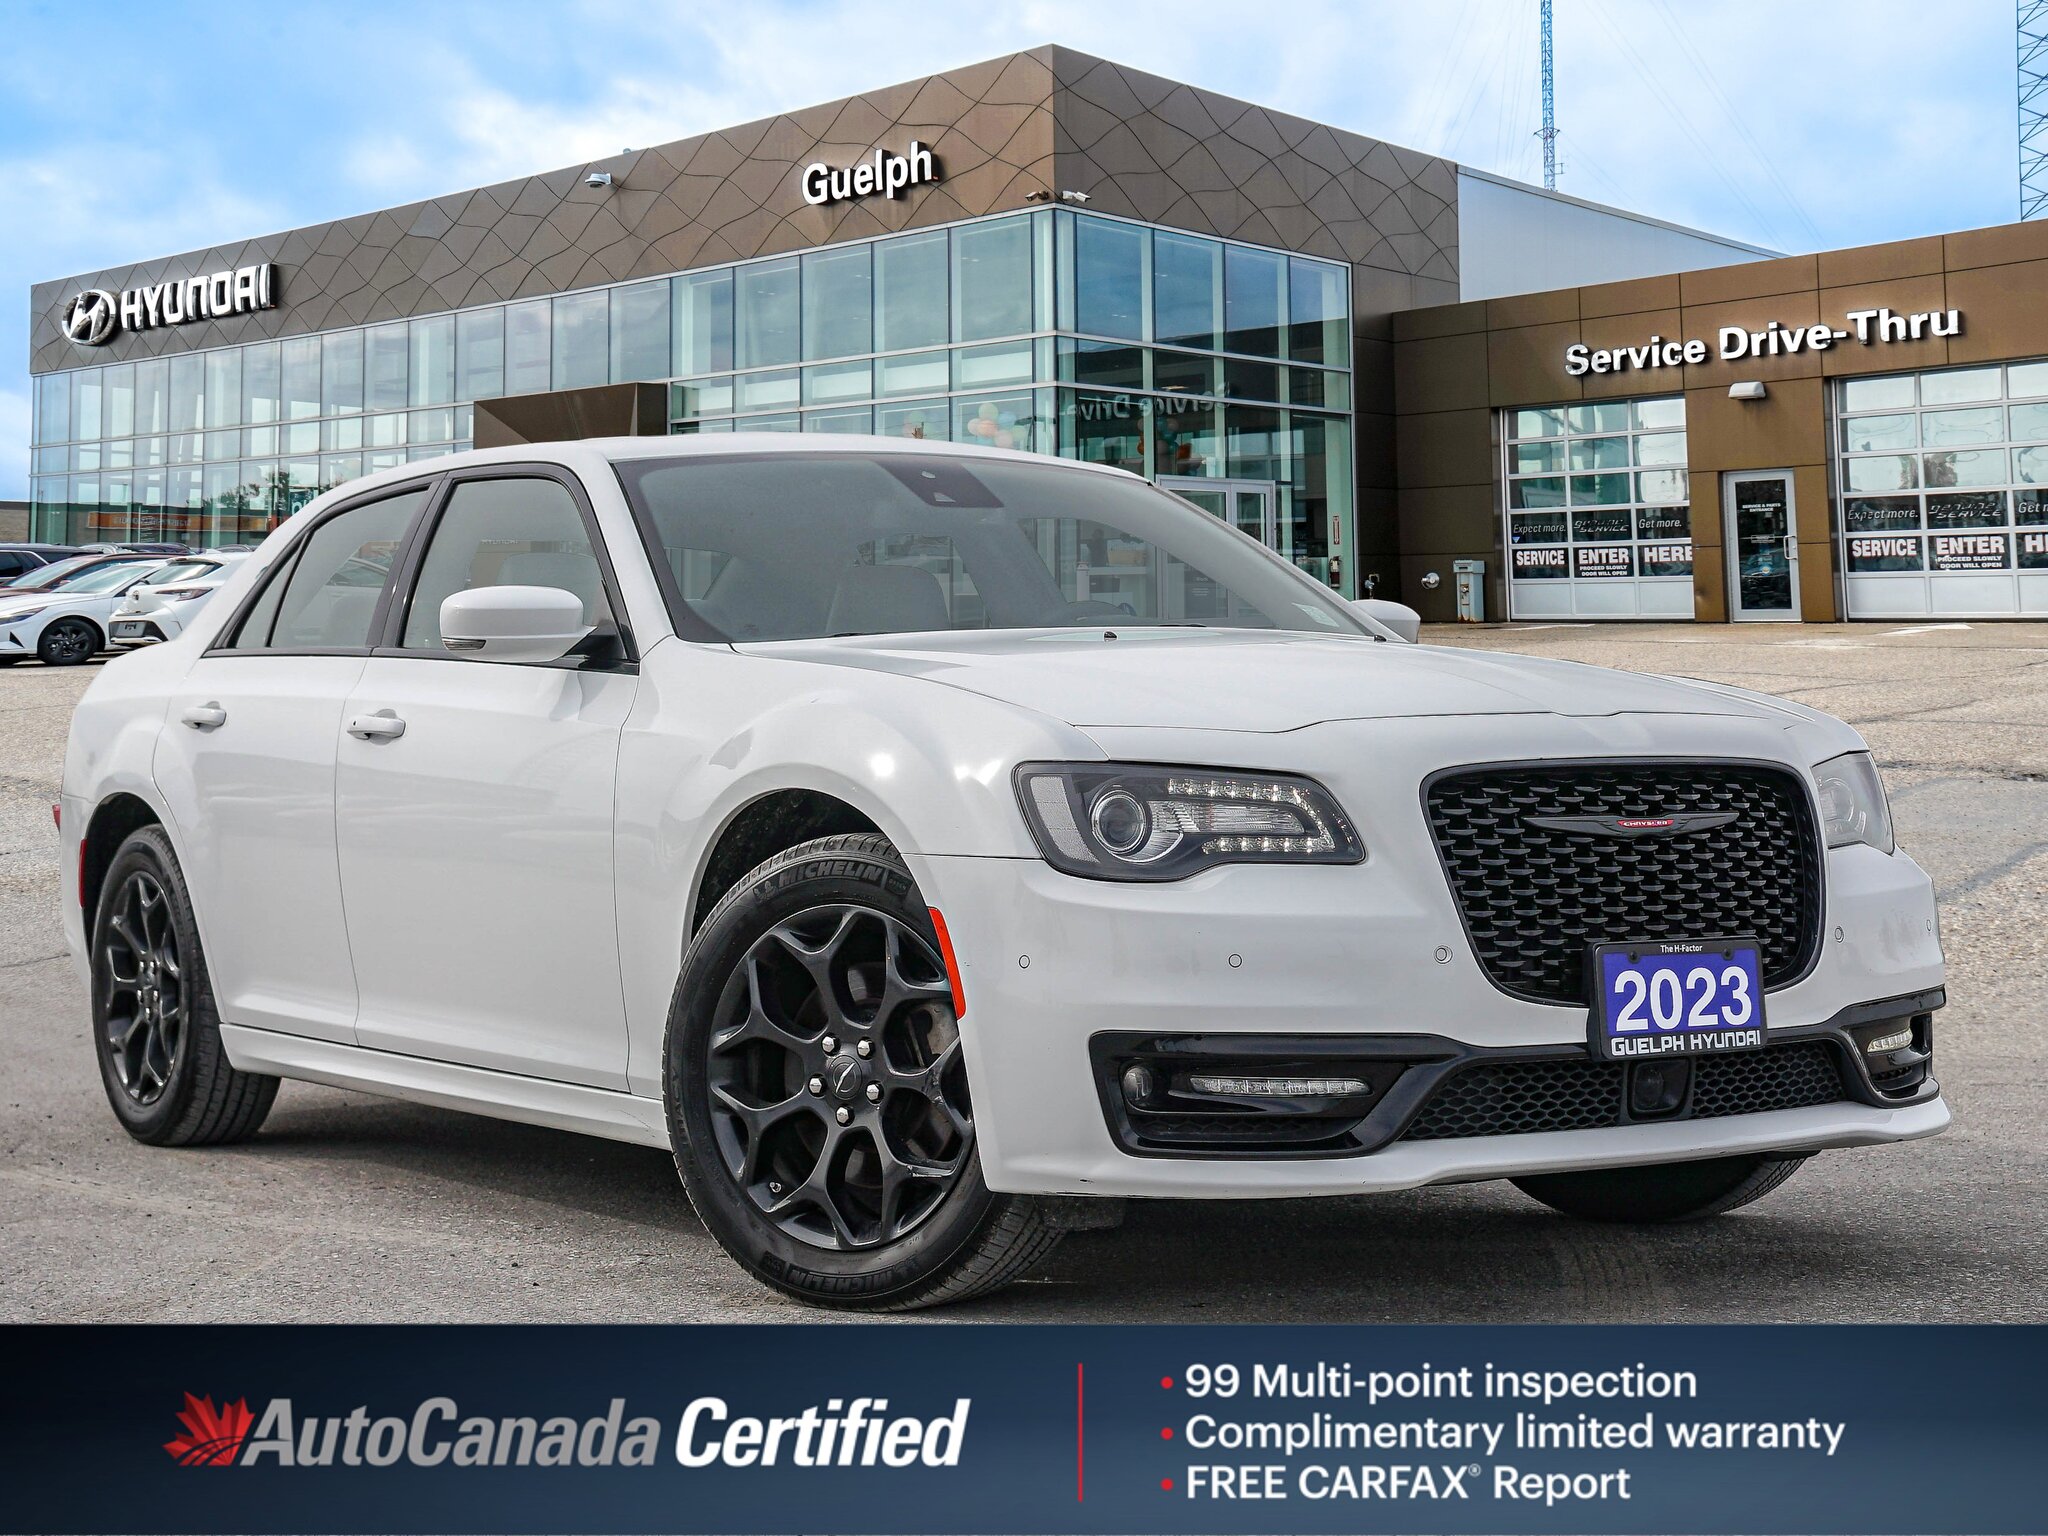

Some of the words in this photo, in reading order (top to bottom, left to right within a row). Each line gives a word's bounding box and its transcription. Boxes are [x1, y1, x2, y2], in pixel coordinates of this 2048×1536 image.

[802, 140, 932, 204] Guelph
[121, 263, 271, 330] HYUNDAI
[1565, 336, 1706, 376] Service
[1719, 309, 1960, 359] Drive-Thru
[1848, 510, 1885, 521] Expect
[1887, 509, 1919, 519] more.
[1936, 509, 2002, 519] SERVICE
[2018, 502, 2040, 514] Get
[1513, 524, 1541, 535] Expect
[1542, 524, 1566, 533] more.
[1638, 518, 1655, 529] Get
[1656, 519, 1682, 528] more.
[1851, 538, 1917, 557] SERVICE
[1936, 536, 2005, 554] ENTER
[2025, 534, 2048, 553] H
[1516, 549, 1565, 566] SERVICE
[1578, 548, 1630, 565] ENTER
[778, 859, 884, 889] MICHELIN
[1659, 944, 1674, 953] The
[1674, 944, 1703, 953] H-Factor
[1614, 966, 1752, 1032] 2023
[1610, 1034, 1685, 1056] GUELPH
[1690, 1029, 1761, 1050] HYUNDAI
